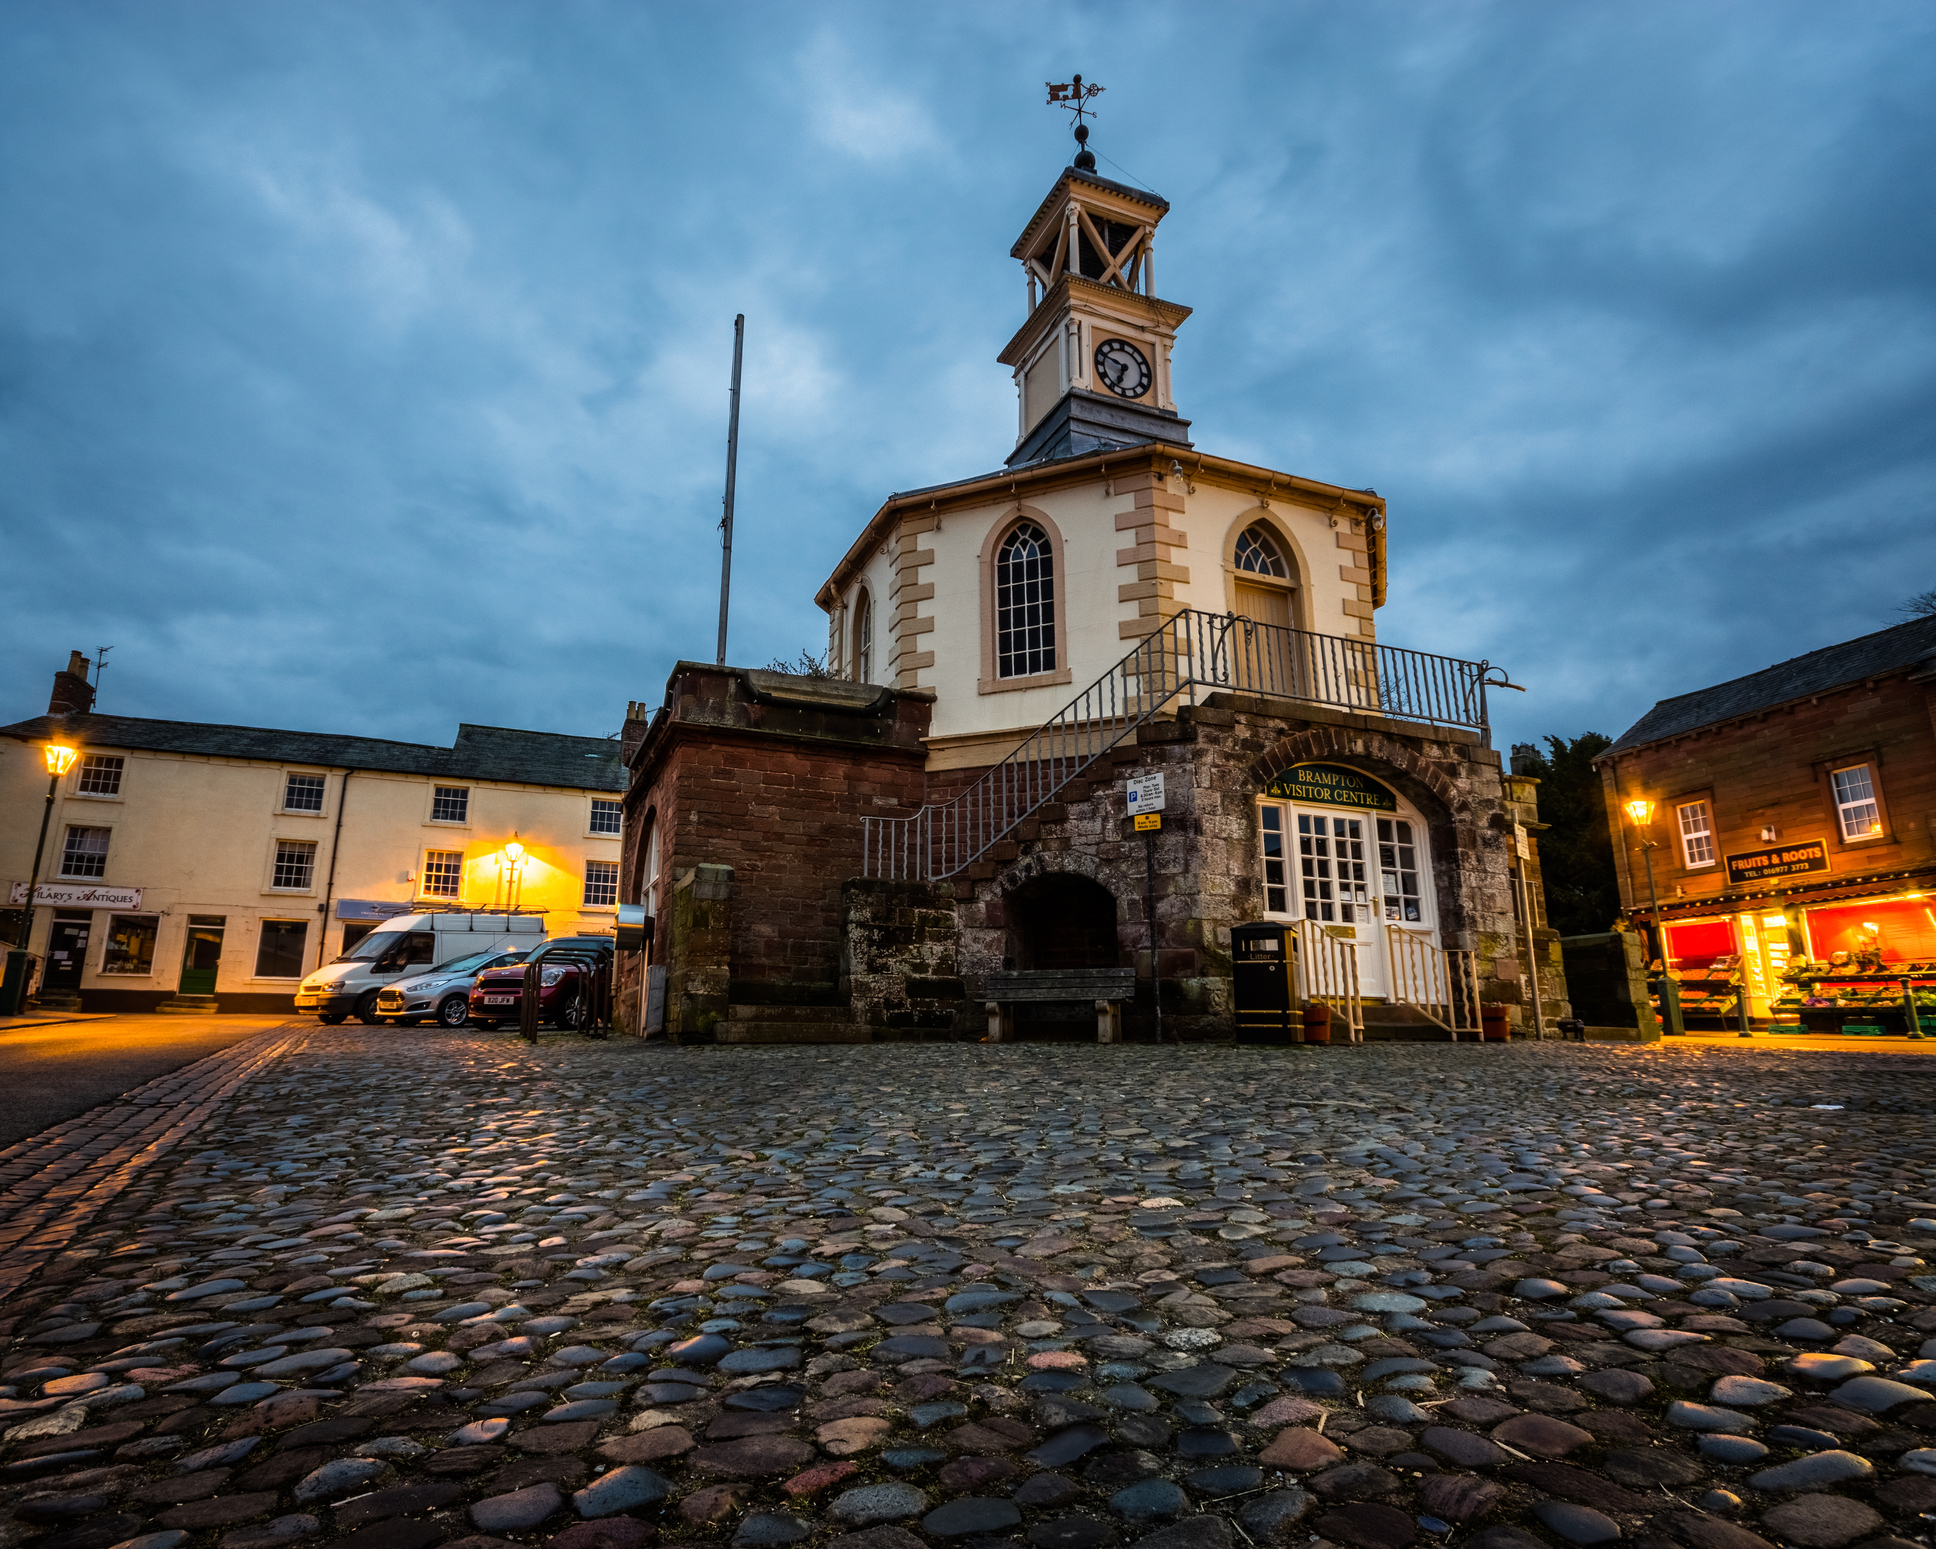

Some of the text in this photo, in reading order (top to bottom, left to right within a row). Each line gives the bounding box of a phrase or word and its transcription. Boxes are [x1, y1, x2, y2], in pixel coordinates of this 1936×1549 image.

[1145, 775, 1157, 783] Zone
[1298, 769, 1364, 789] BRAMPTON
[1283, 783, 1381, 806] VISITOR CENTRE
[1731, 847, 1822, 871] FRUITS & ROOTS
[1743, 862, 1809, 878] TEL: 016977 3773
